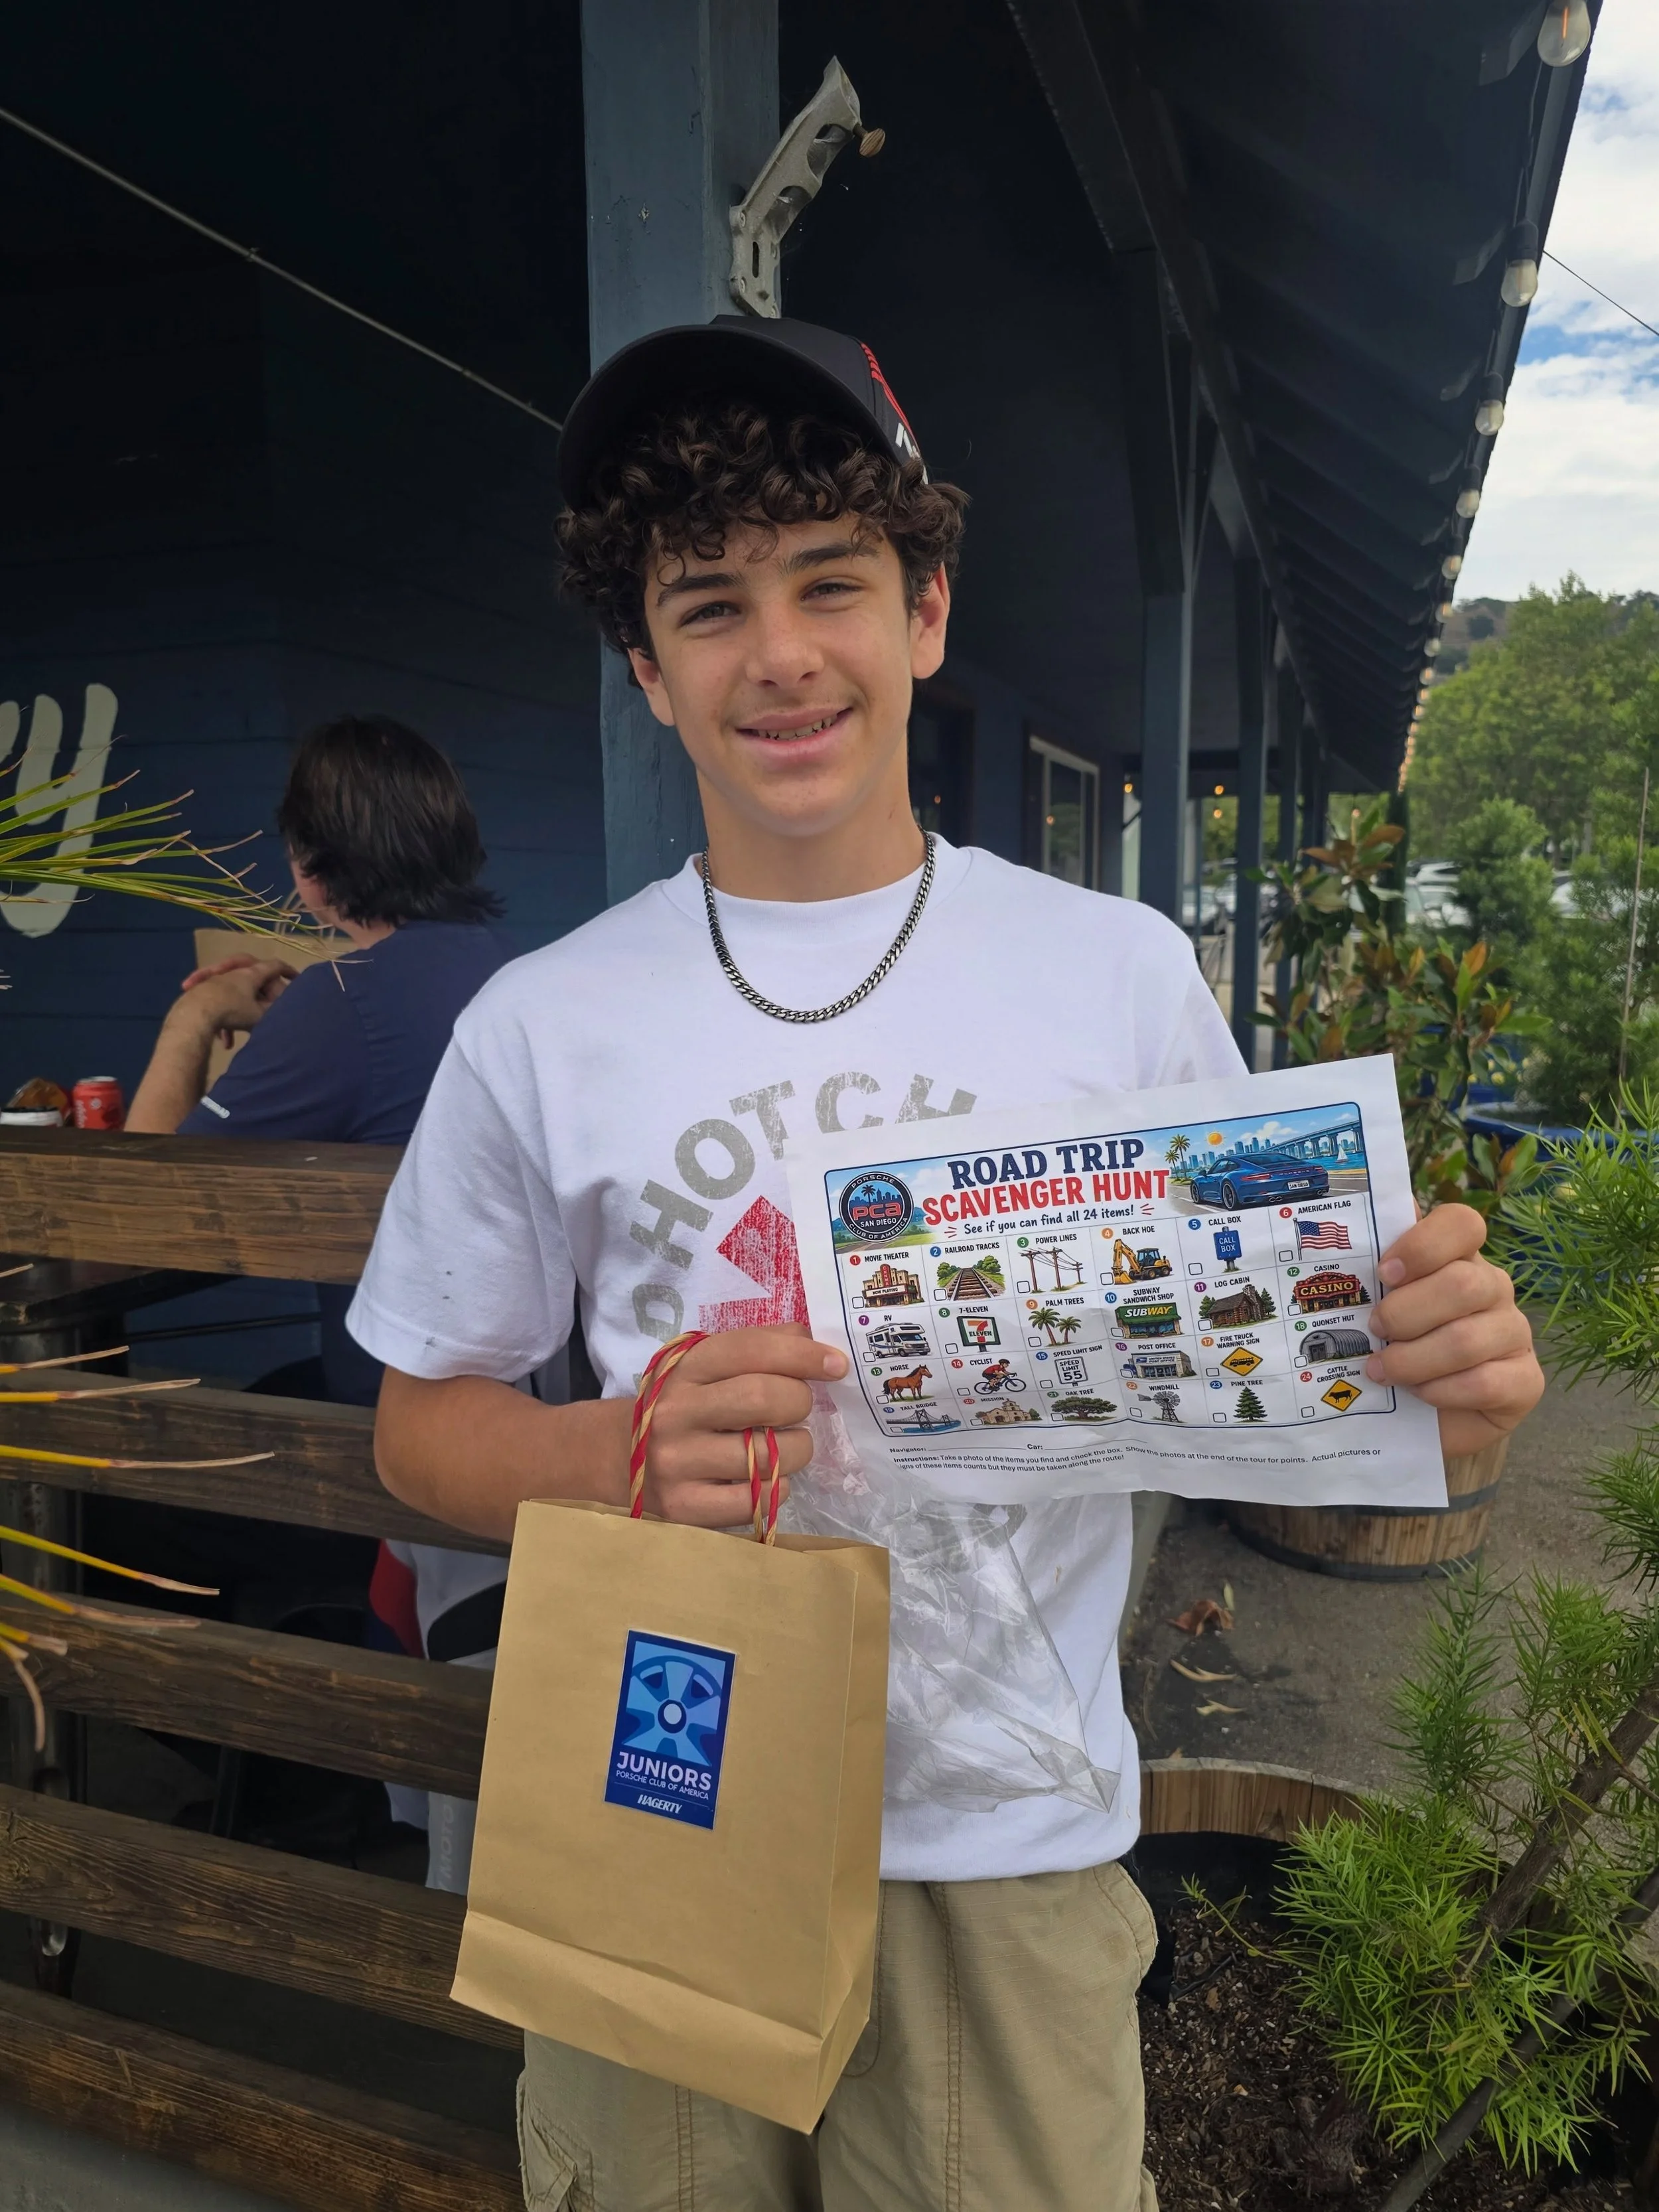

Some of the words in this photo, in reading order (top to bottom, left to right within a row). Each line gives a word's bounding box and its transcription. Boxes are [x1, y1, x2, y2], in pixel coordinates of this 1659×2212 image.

[947, 1149, 1047, 1190] ROAD
[1056, 1138, 1144, 1174] TRIP
[851, 1174, 896, 1189] PORSCHE
[922, 1177, 1086, 1226] SCAVENGER
[1092, 1169, 1170, 1203] HUNT
[1297, 1203, 1333, 1215] AMERICAN
[1334, 1200, 1351, 1209] FLAG
[860, 1220, 875, 1228] SAN
[876, 1217, 897, 1226] DIEGO
[964, 1223, 983, 1234] See
[986, 1221, 995, 1232] if
[998, 1221, 1016, 1234] you
[1019, 1218, 1037, 1228] can
[1041, 1213, 1063, 1226] find
[1066, 1211, 1079, 1222] all
[1083, 1209, 1098, 1220] 24
[1101, 1205, 1134, 1219] items!
[1228, 1215, 1242, 1224] BOX
[849, 1222, 867, 1238] CLUB
[880, 1217, 908, 1239] AMERICA
[1035, 1236, 1058, 1244] POWER
[1059, 1233, 1077, 1242] LINES
[944, 1246, 975, 1255] RAILROAD
[976, 1242, 1000, 1251] TRACKS
[1221, 1244, 1236, 1252] BOX
[883, 1252, 909, 1261] THEATER
[1313, 1264, 1340, 1272] CASINO
[1214, 1279, 1228, 1288] LOG
[1229, 1276, 1250, 1286] CABIN
[1300, 1281, 1354, 1295] CASINO
[1133, 1286, 1161, 1295] SUBWAY
[1064, 1297, 1084, 1305] TREES
[1123, 1294, 1156, 1305] SANDWICH
[1157, 1292, 1175, 1301] SHOP
[959, 1305, 989, 1314] 7-ELEVEN
[1124, 1305, 1173, 1318] SUBWAY
[1312, 1317, 1340, 1327] QUONSET
[967, 1319, 988, 1343] 7
[1216, 1340, 1245, 1349] WARNING
[1063, 1370, 1083, 1381] 55
[1327, 1365, 1348, 1374] CATTLE
[1317, 1372, 1345, 1383] CROSSING
[1070, 1451, 1092, 1461] check
[1311, 1451, 1336, 1462] Actual
[1337, 1449, 1370, 1459] pictures
[1068, 1461, 1088, 1469] along
[616, 1751, 713, 1791] JUNIORS
[616, 1769, 648, 1784] PORSCHE
[648, 1777, 666, 1788] CLUB
[668, 1782, 678, 1791] OF
[679, 1785, 709, 1801] AMERICA
[637, 1793, 682, 1814] HAGERTY
